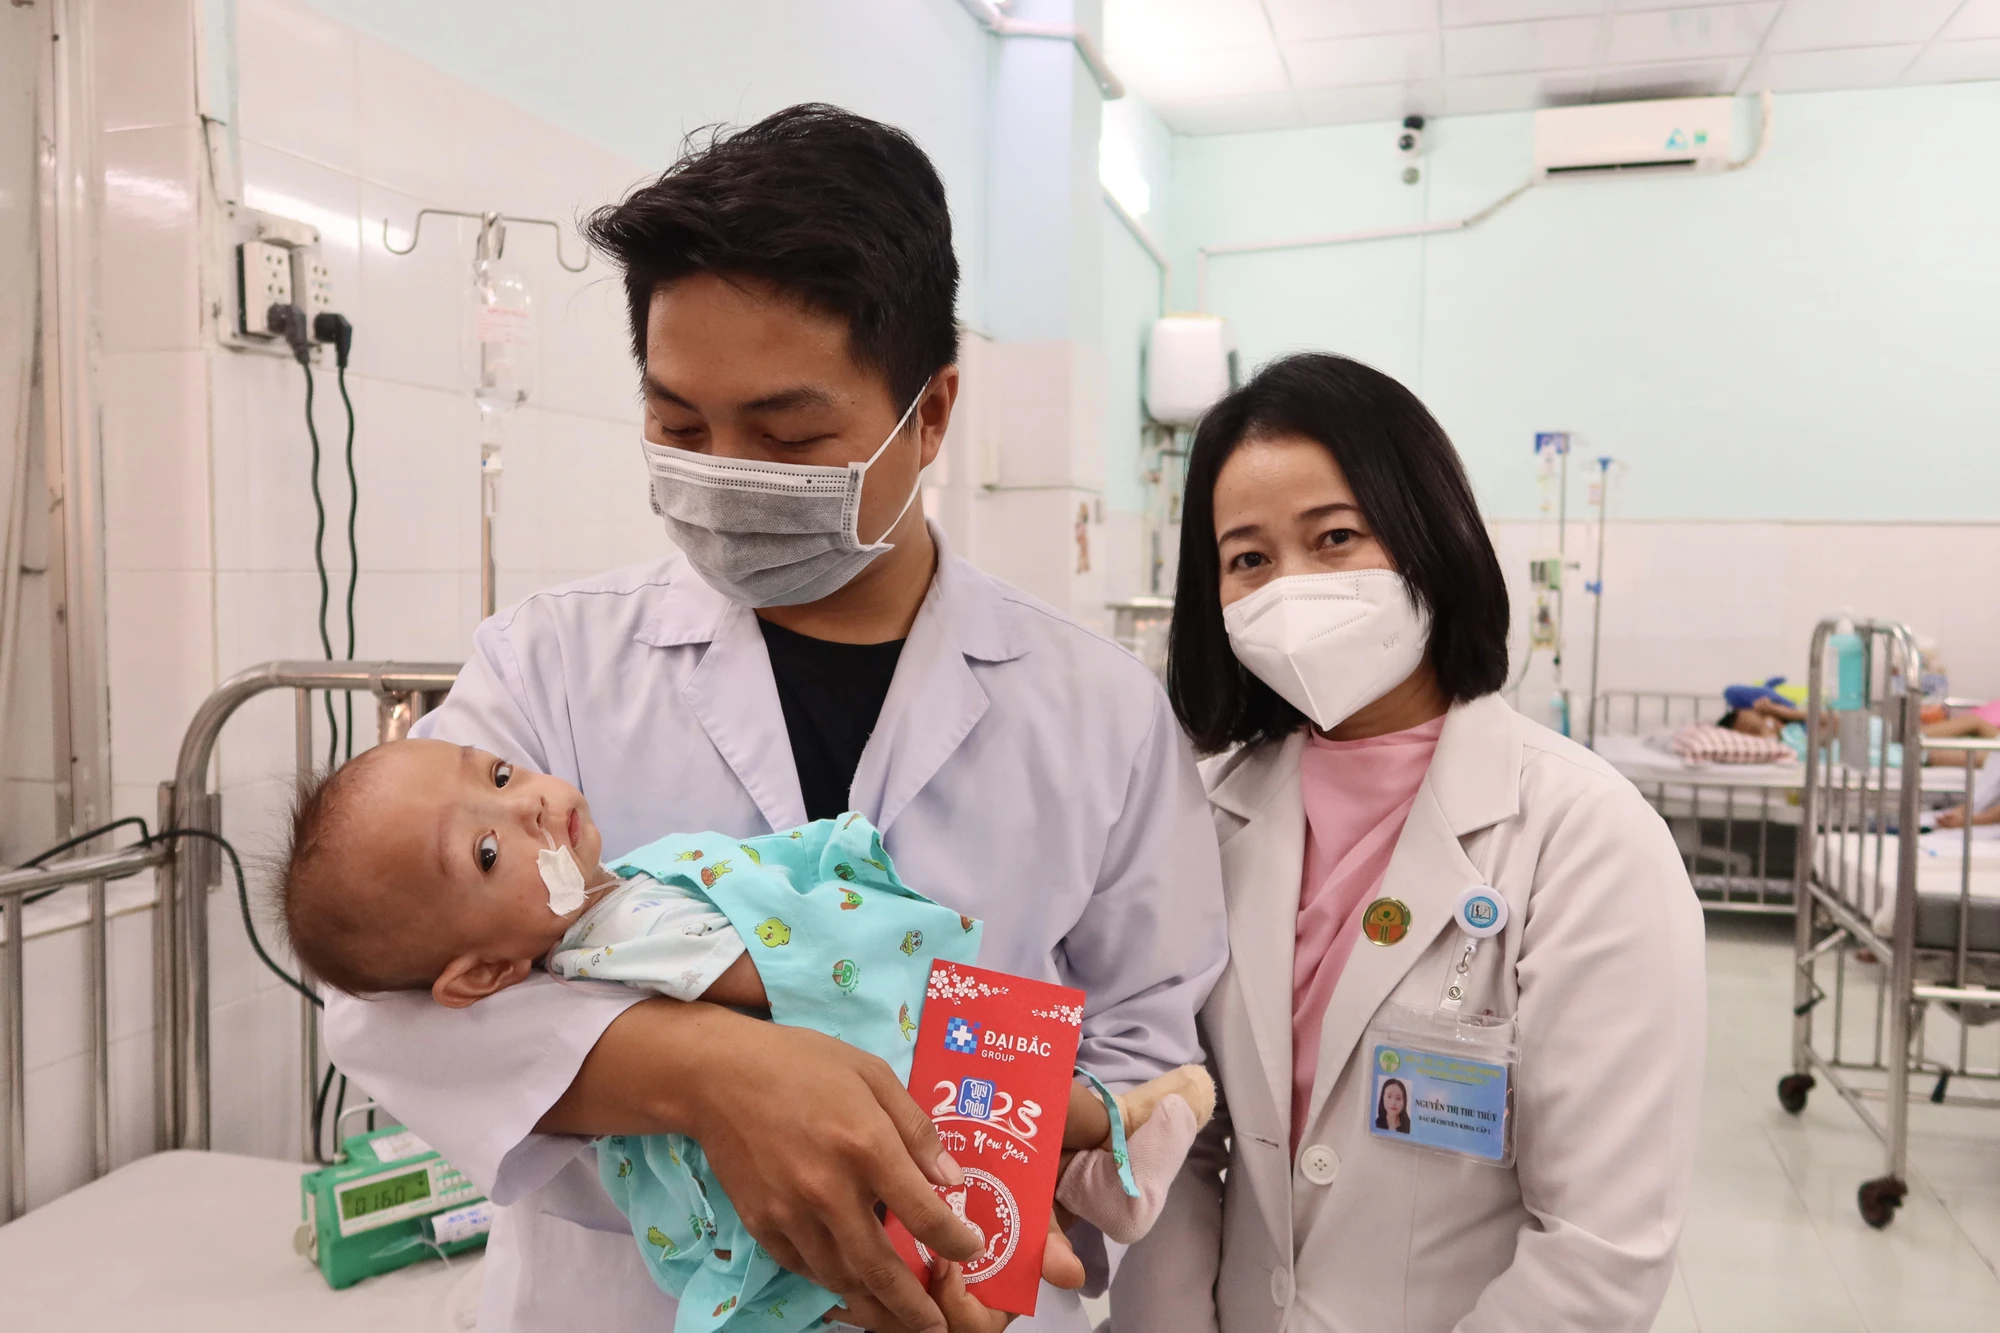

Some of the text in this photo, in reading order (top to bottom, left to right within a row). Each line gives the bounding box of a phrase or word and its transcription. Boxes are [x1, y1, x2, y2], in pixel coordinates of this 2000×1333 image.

[1382, 632, 1400, 652] N95
[984, 1030, 1052, 1057] ĐẠI BẮC
[981, 1049, 1015, 1062] GROUP
[1460, 1107, 1475, 1117] THU
[973, 1130, 1002, 1154] New
[1001, 1140, 1029, 1164] Year
